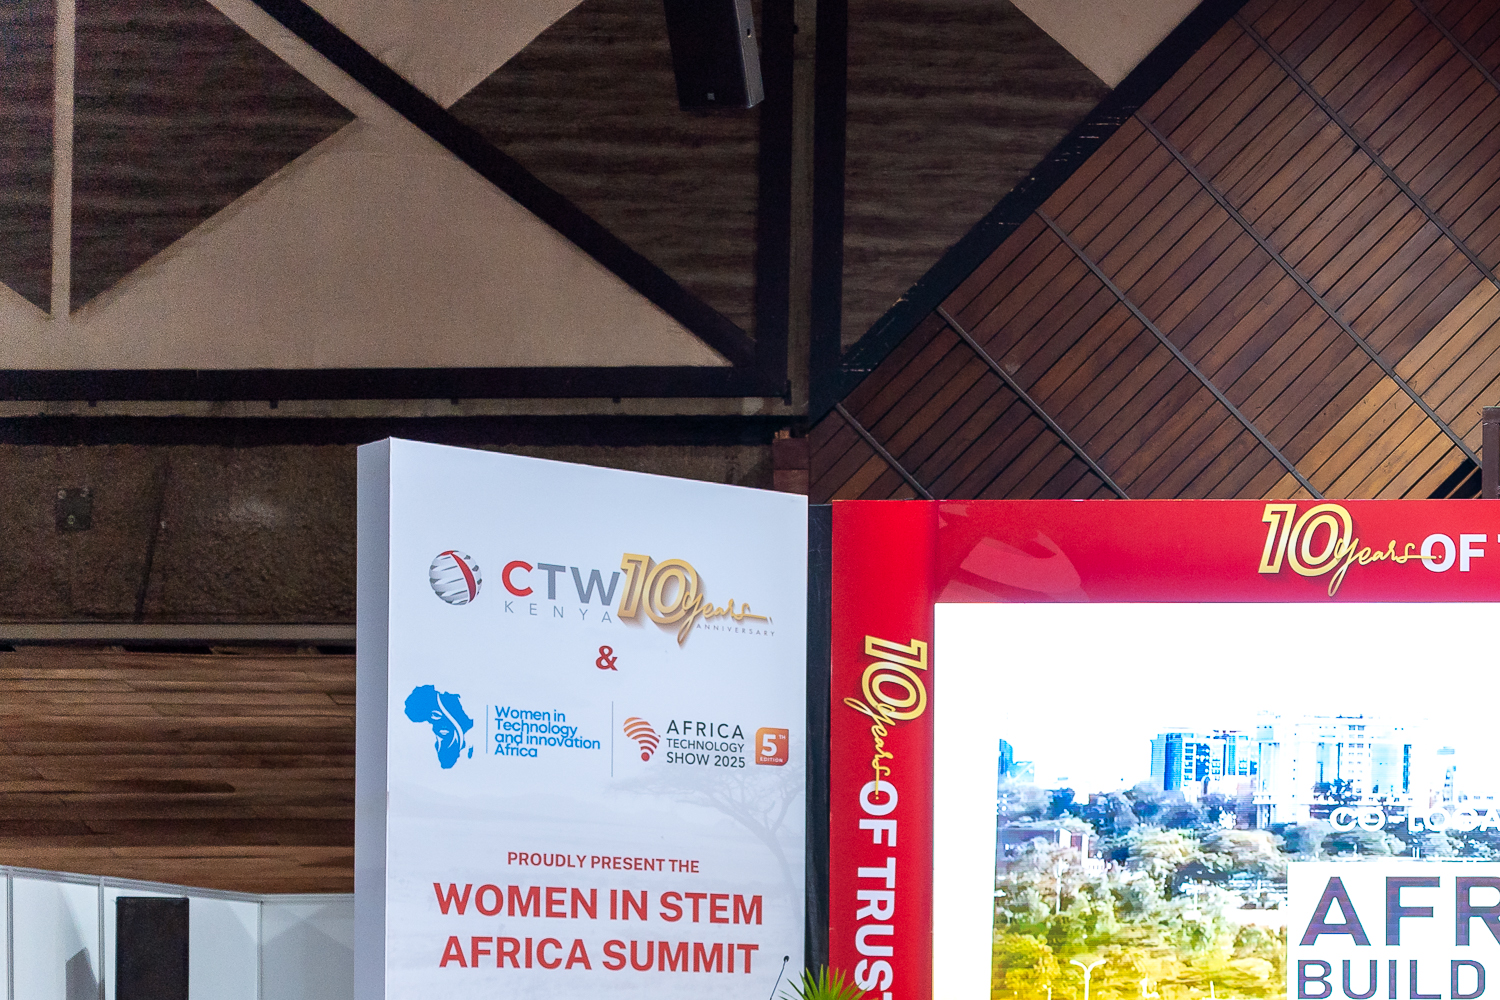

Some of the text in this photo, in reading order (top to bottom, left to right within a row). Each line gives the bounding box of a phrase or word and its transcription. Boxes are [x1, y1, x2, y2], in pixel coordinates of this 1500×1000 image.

[1258, 503, 1353, 576] 10
[1420, 533, 1487, 573] OF
[501, 559, 620, 606] CTW
[618, 552, 699, 625] 10
[504, 600, 775, 638] KENYA ANNIVERSARY
[595, 645, 619, 672] &
[862, 635, 928, 722] 10
[495, 706, 565, 722] Women in
[495, 718, 578, 738] Technology
[495, 732, 600, 750] and innovation
[667, 719, 744, 740] AFRICA
[494, 743, 538, 758] Africa
[667, 738, 744, 753] TECHNOLOGY
[666, 752, 746, 768] SHOW 2025
[858, 780, 899, 847] OF
[508, 851, 699, 873] PROUDLY PRESENT THE
[433, 882, 763, 925] WOMEN IN STEM
[439, 935, 759, 974] AFRICA SUMMIT
[1297, 959, 1486, 1000] BUILD
